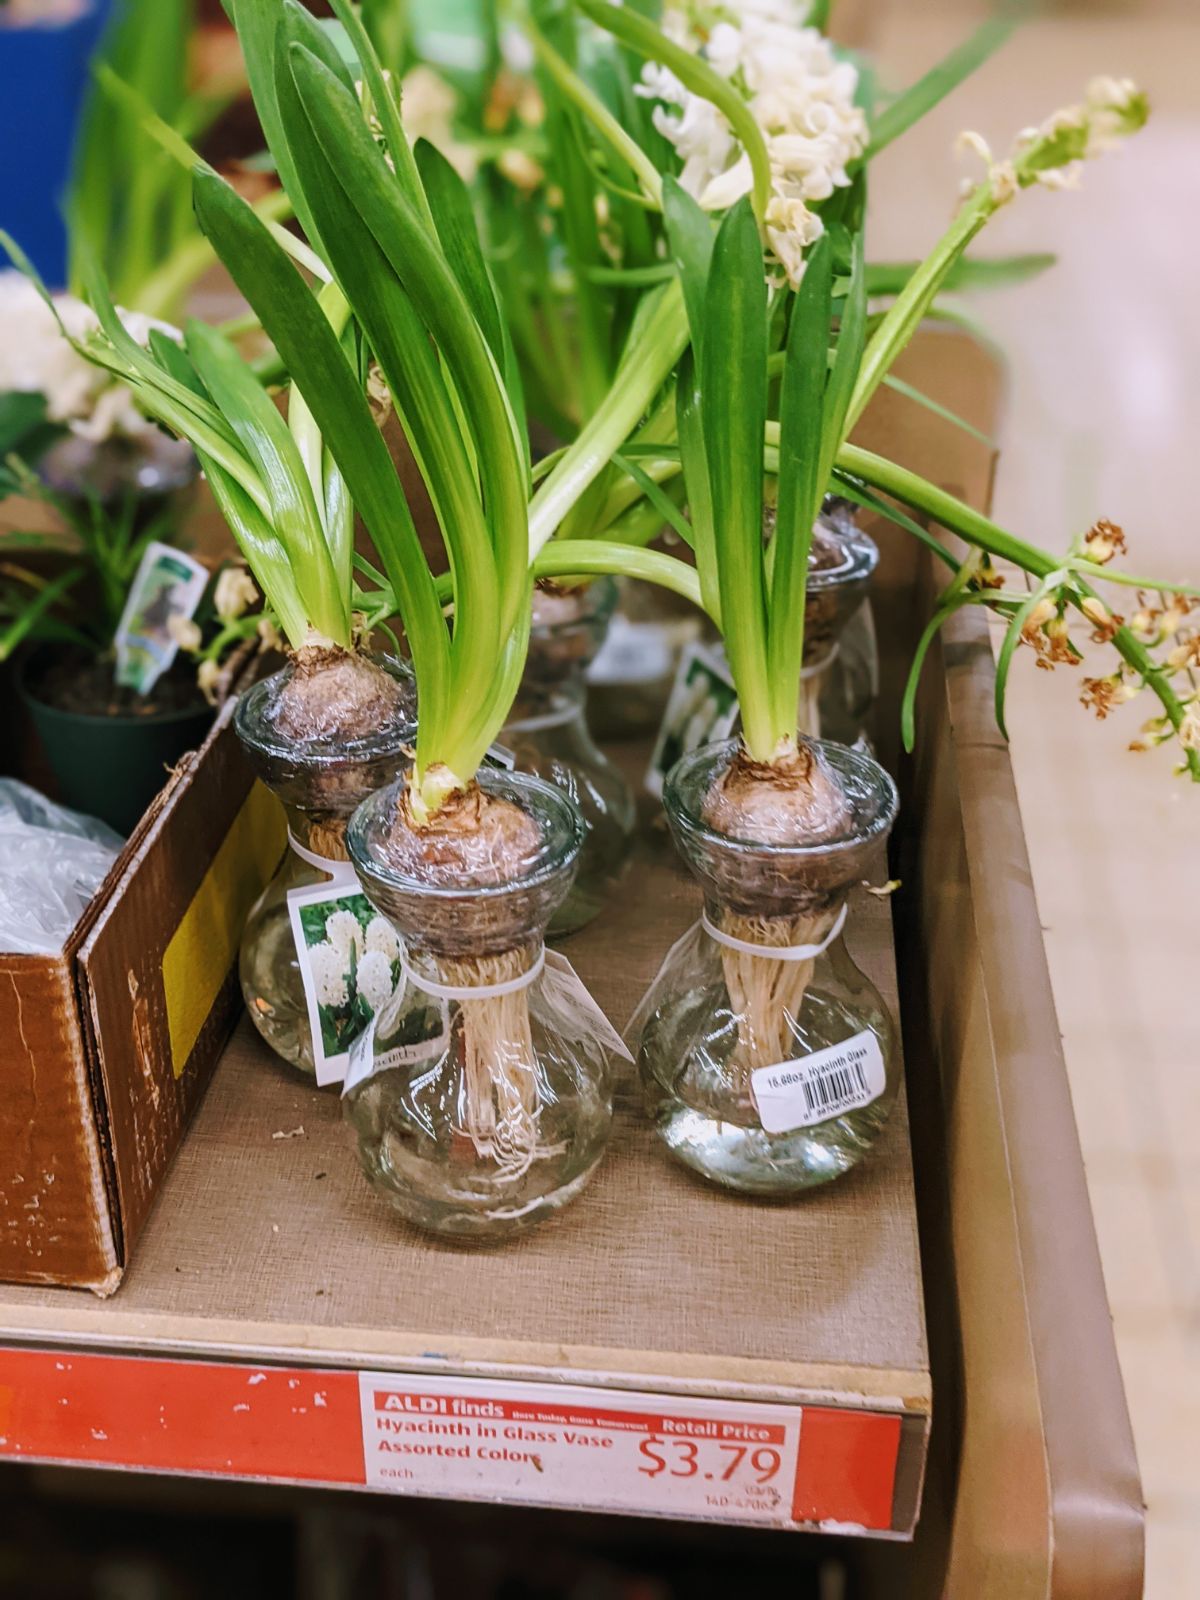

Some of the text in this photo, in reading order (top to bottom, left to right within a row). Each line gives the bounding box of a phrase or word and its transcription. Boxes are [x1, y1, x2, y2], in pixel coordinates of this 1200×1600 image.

[808, 1055, 847, 1078] Hyacinth
[847, 1047, 868, 1061] Glass
[384, 1394, 504, 1417] ALDI finds
[376, 1417, 613, 1448] Hyacinth in Glass Vase
[662, 1418, 770, 1440] Retail Price
[378, 1440, 470, 1458] Assorted
[638, 1433, 781, 1483] $3.79
[380, 1468, 413, 1479] each
